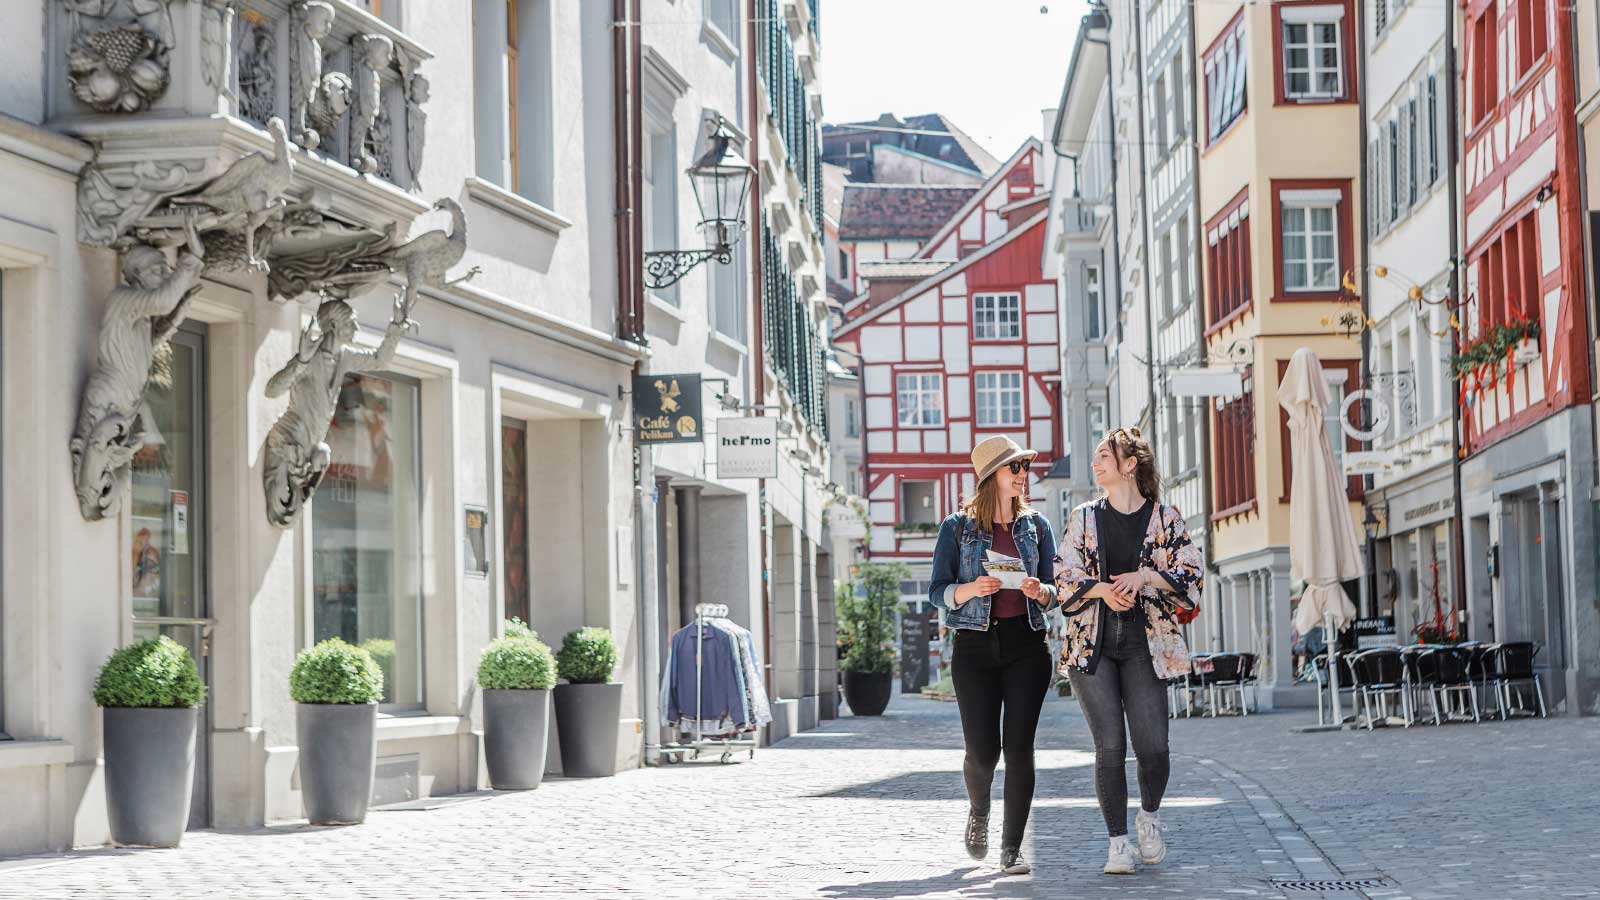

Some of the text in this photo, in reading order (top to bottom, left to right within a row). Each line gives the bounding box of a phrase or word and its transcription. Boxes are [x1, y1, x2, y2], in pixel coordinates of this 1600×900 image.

[640, 415, 670, 430] Café
[640, 430, 673, 440] Pelikan
[722, 435, 771, 446] hermo
